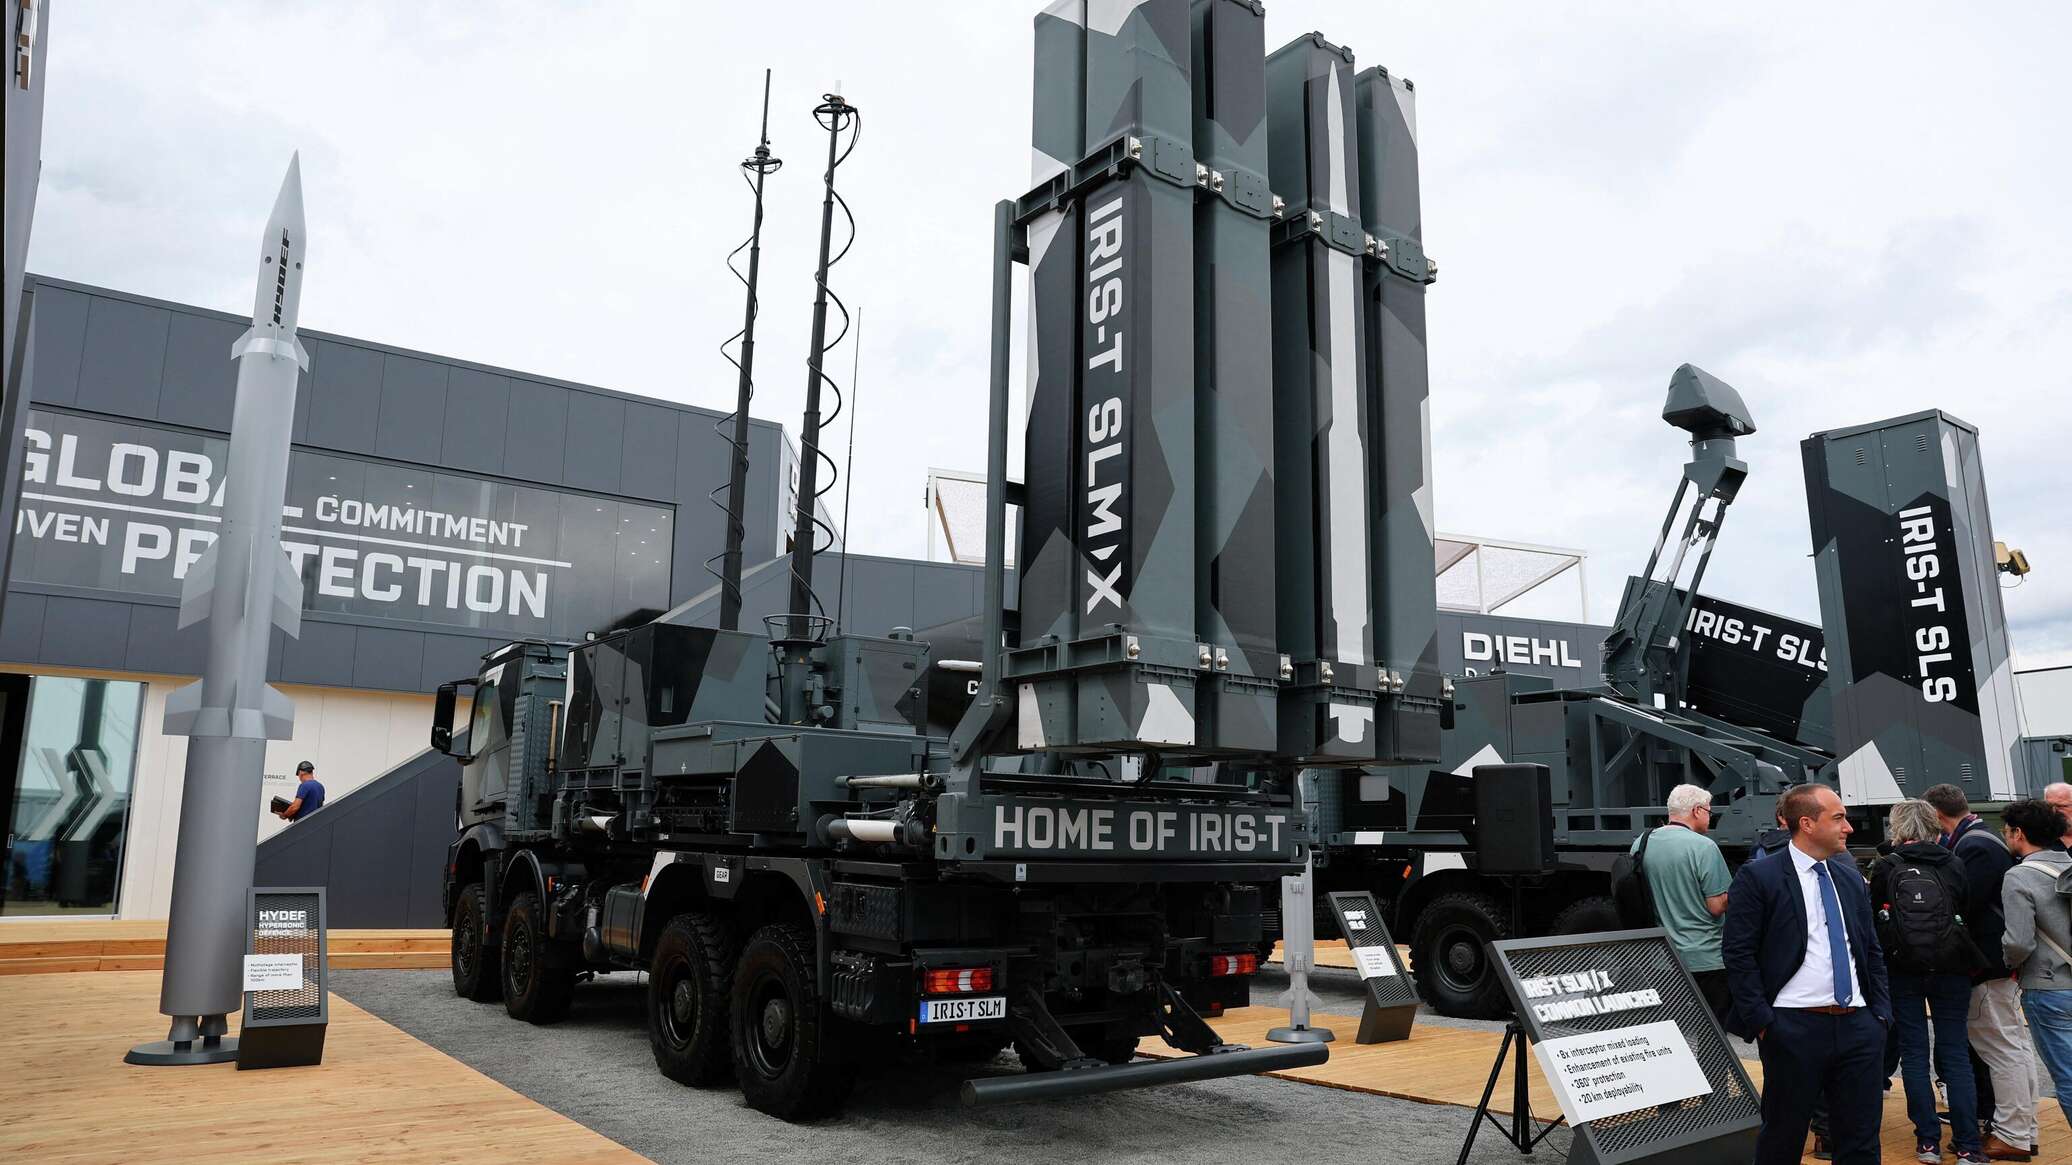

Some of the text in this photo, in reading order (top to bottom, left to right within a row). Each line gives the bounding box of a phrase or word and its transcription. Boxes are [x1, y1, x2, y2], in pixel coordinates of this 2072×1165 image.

[270, 227, 290, 326] HYDEF
[1088, 196, 1123, 373] IRIS-T
[24, 428, 528, 547] GLOB COMMITMENT
[121, 520, 548, 618] PRTECTION
[1899, 505, 1957, 703] IRIS-T SLS
[1686, 608, 1771, 651] IRIS-T
[1463, 632, 1582, 668] DIEHL
[994, 805, 1286, 852] HOME OF IRIS-T
[259, 911, 307, 921] HYDEF
[1520, 976, 1562, 998] IRIS-T
[978, 1000, 1002, 1017] SLM
[1532, 988, 1664, 1023] COMMON LAUNCHER
[1559, 1035, 1650, 1059] 8x interceptor mixed loading
[1566, 1046, 1673, 1074] Enhancement of existing fire units
[1581, 1082, 1644, 1104] 20 km deployability
[1591, 1070, 1626, 1087] protection
